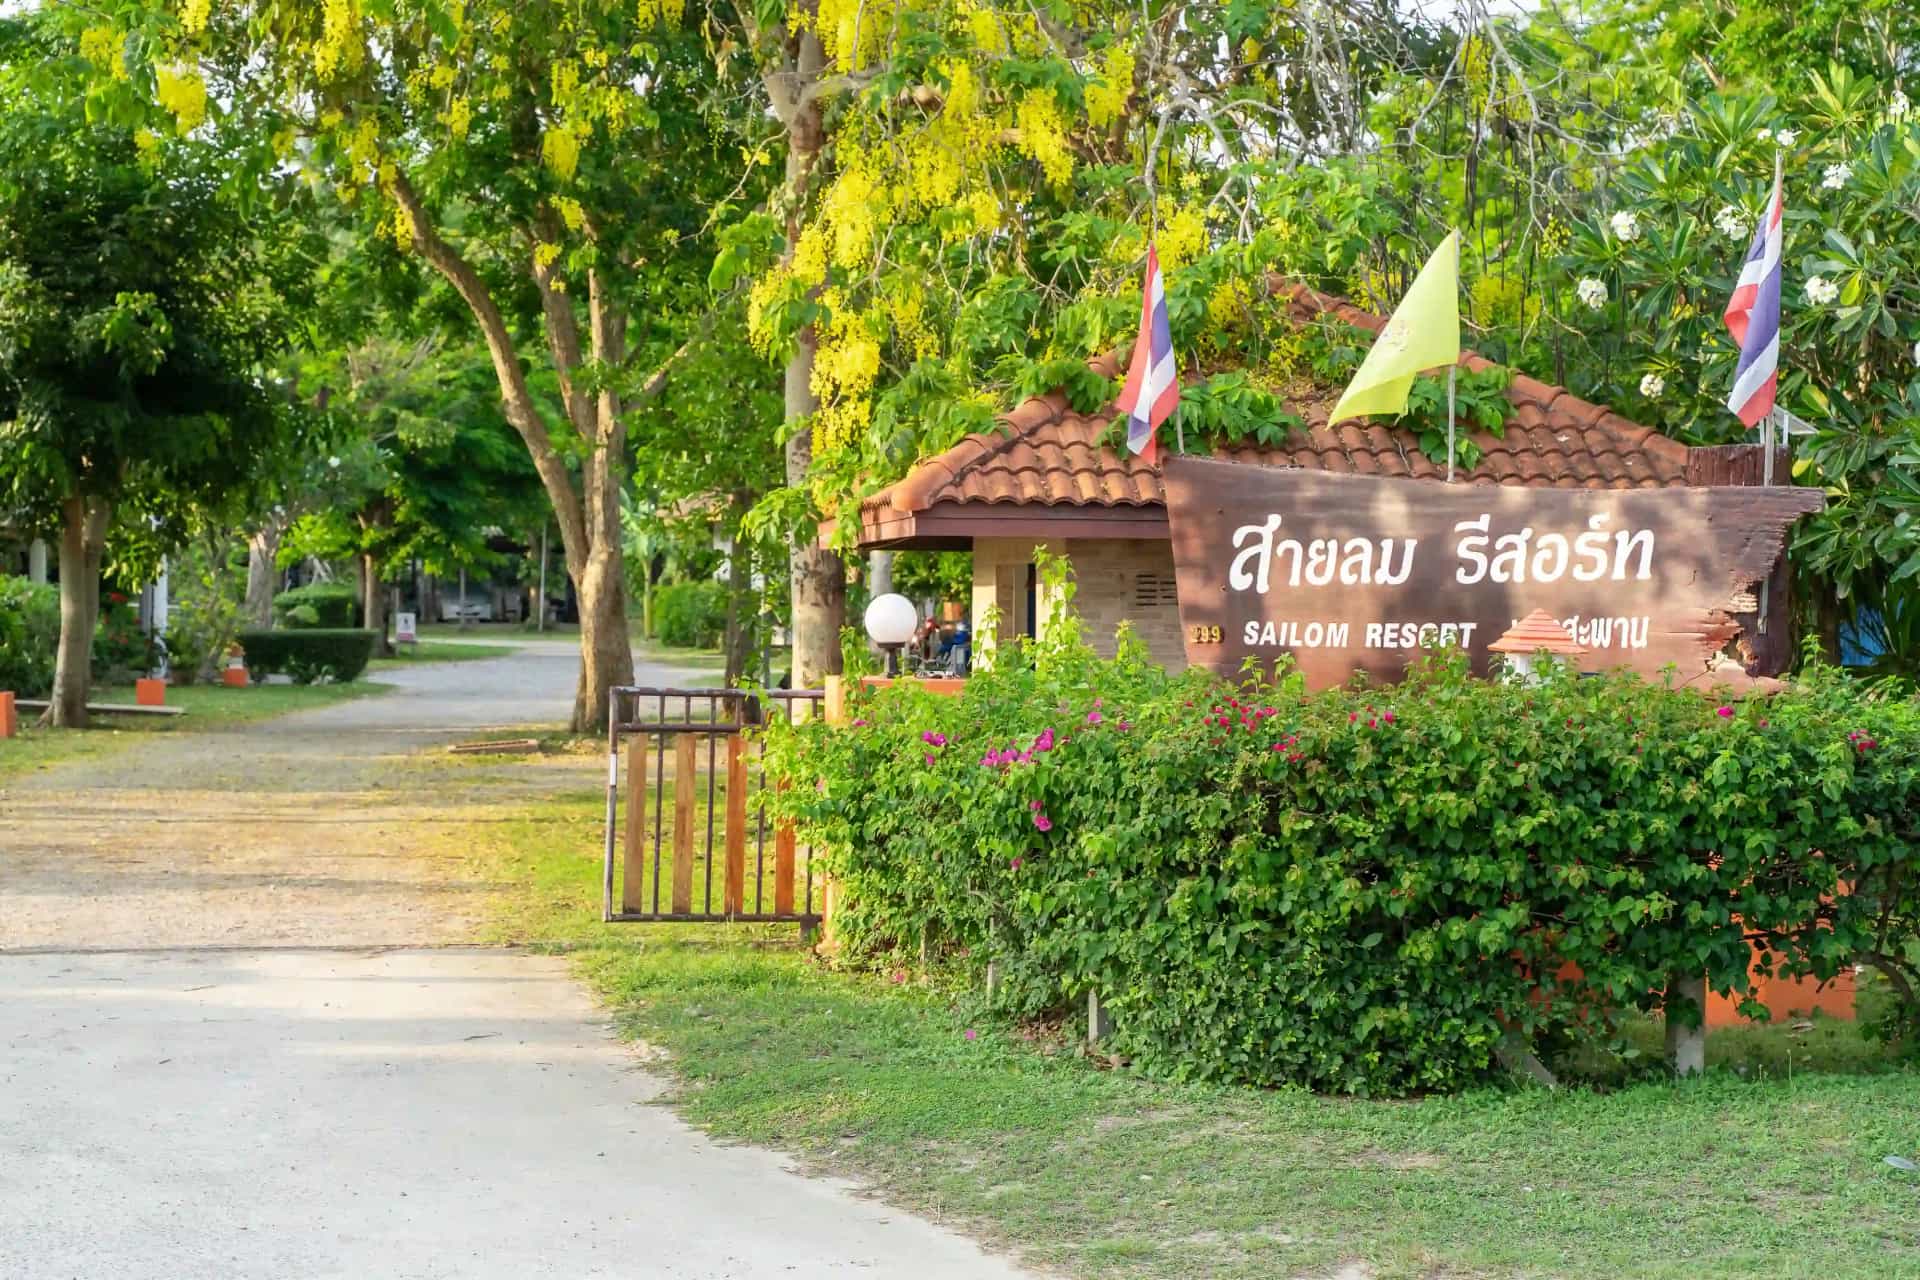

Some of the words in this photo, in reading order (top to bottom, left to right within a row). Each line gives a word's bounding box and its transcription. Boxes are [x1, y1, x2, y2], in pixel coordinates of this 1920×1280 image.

[1229, 513, 1418, 594] สายลม
[1454, 513, 1655, 584] รีสอร์ท
[1243, 620, 1349, 648] SAILOM
[1365, 622, 1478, 648] RESORT
